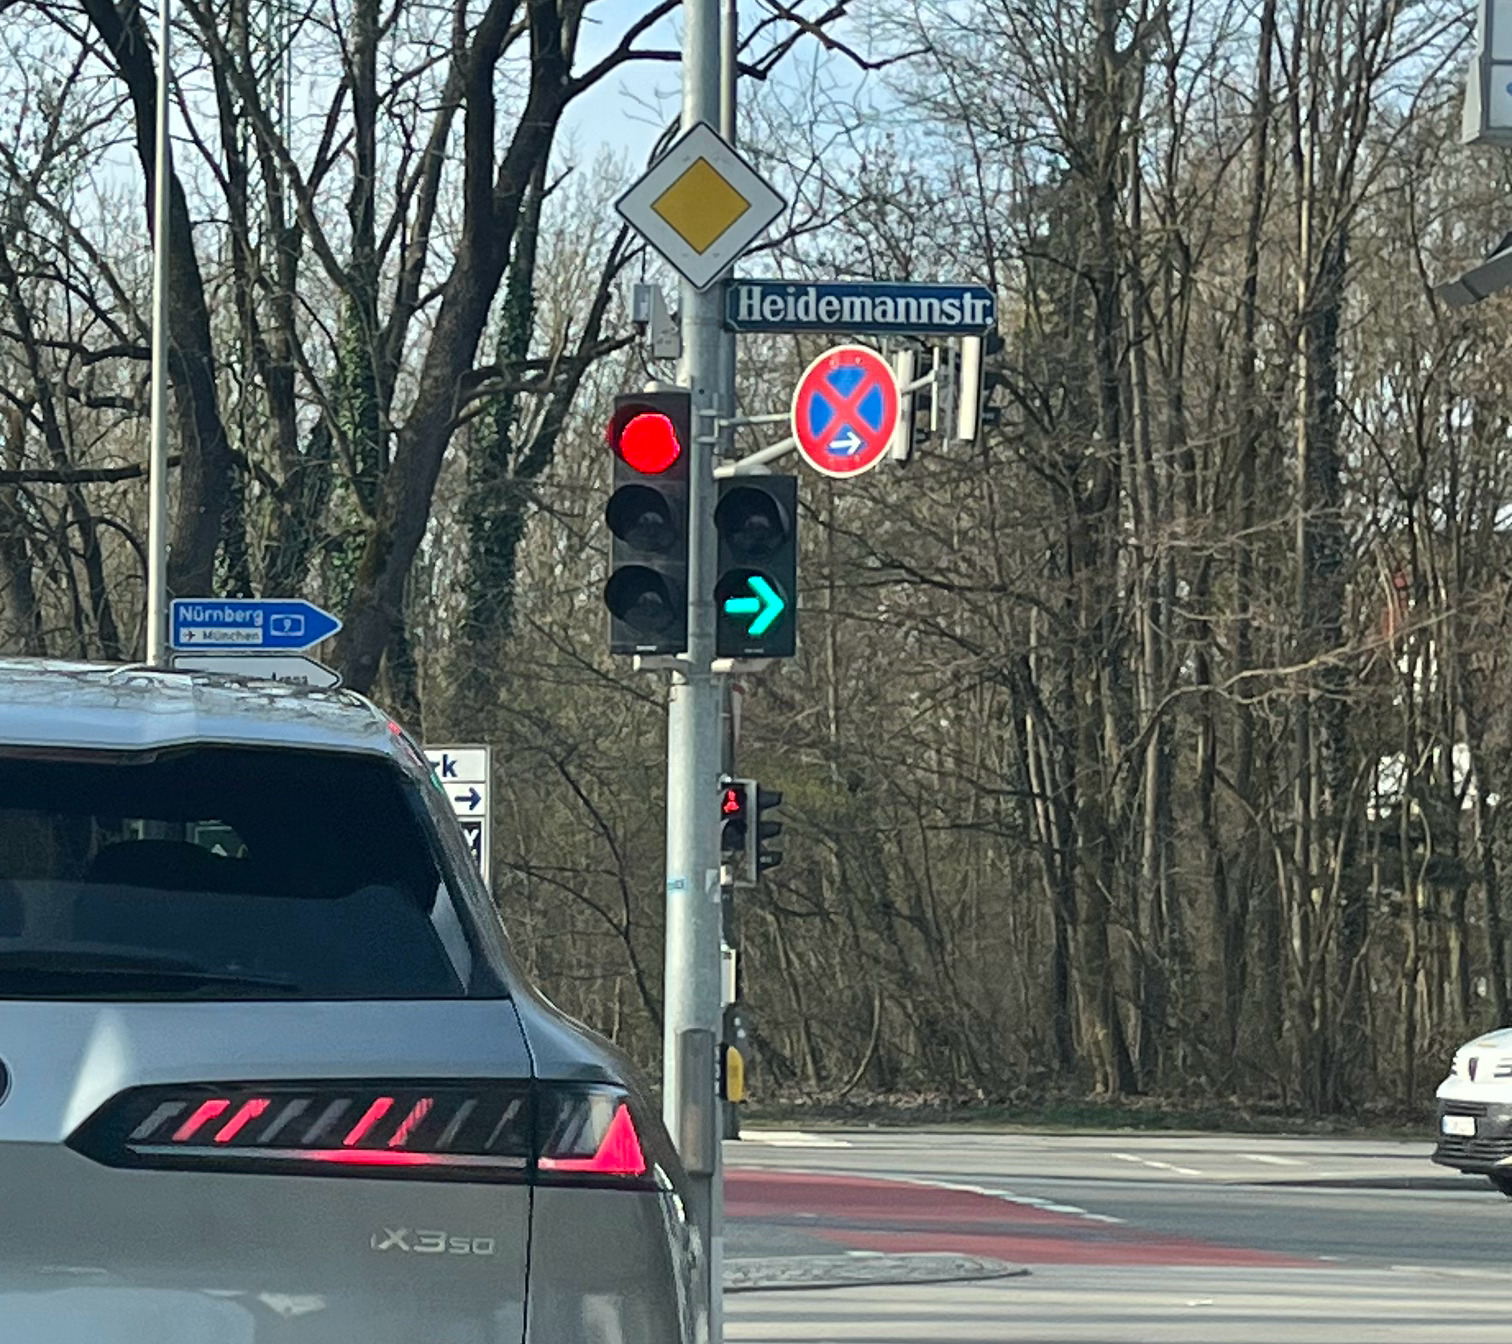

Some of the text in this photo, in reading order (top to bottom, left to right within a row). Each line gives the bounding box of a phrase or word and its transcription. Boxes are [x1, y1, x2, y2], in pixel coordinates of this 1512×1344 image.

[738, 285, 994, 325] Heidemannstr.
[179, 606, 291, 632] Nürnberg 9
